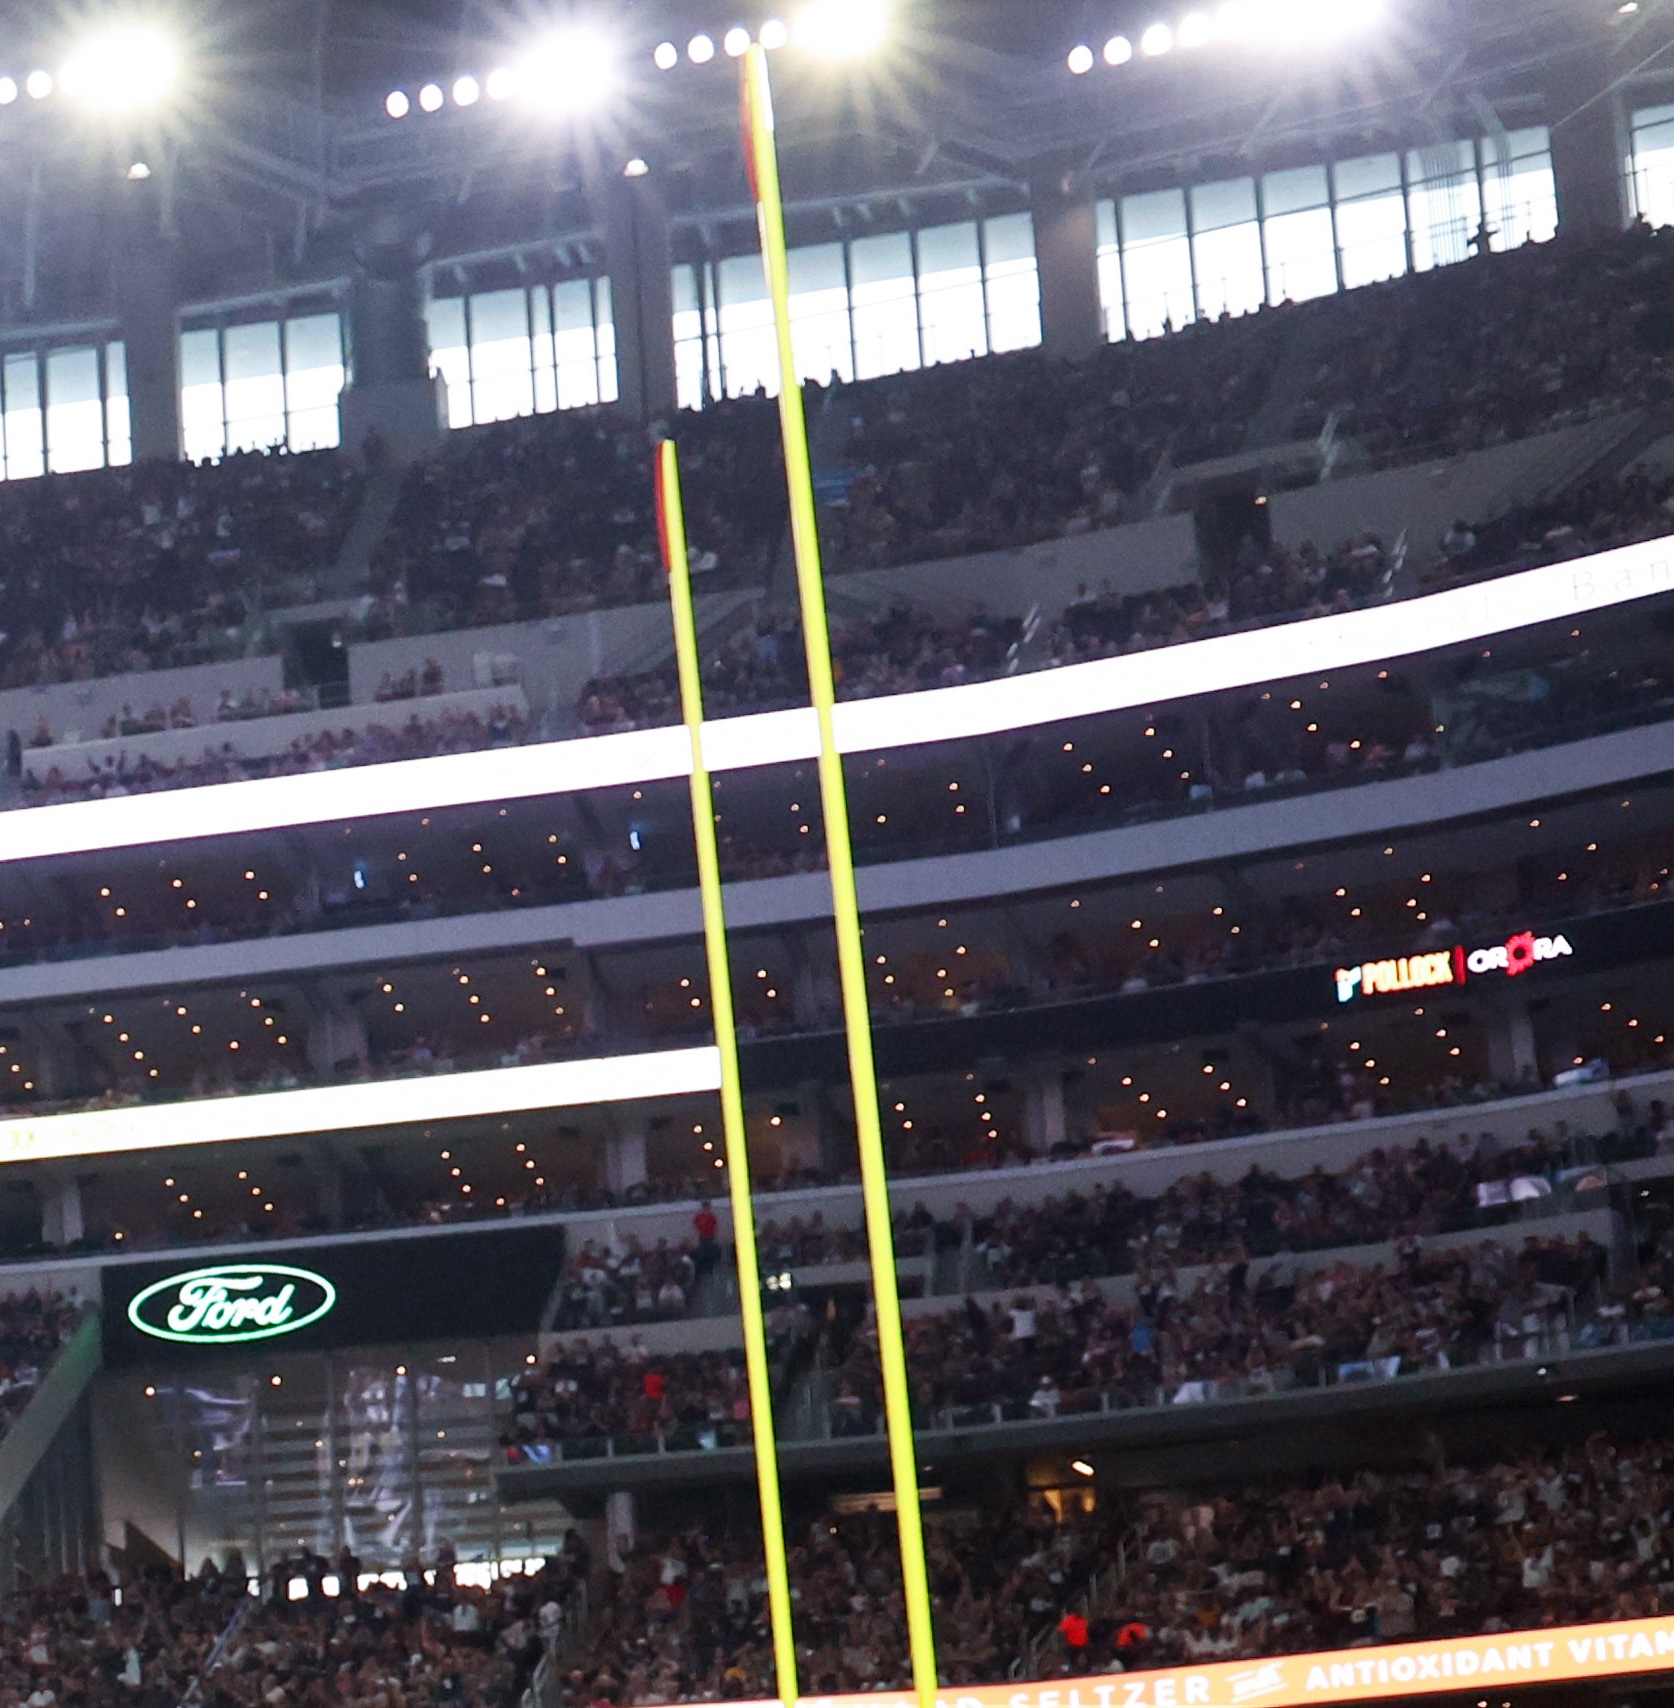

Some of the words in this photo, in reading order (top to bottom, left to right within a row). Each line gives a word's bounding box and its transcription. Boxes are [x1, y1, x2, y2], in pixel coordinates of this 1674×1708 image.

[1362, 951, 1453, 995] POLLOCK
[167, 1275, 295, 1332] Ford
[1305, 1641, 1554, 1691] ANTIOXIDANT
